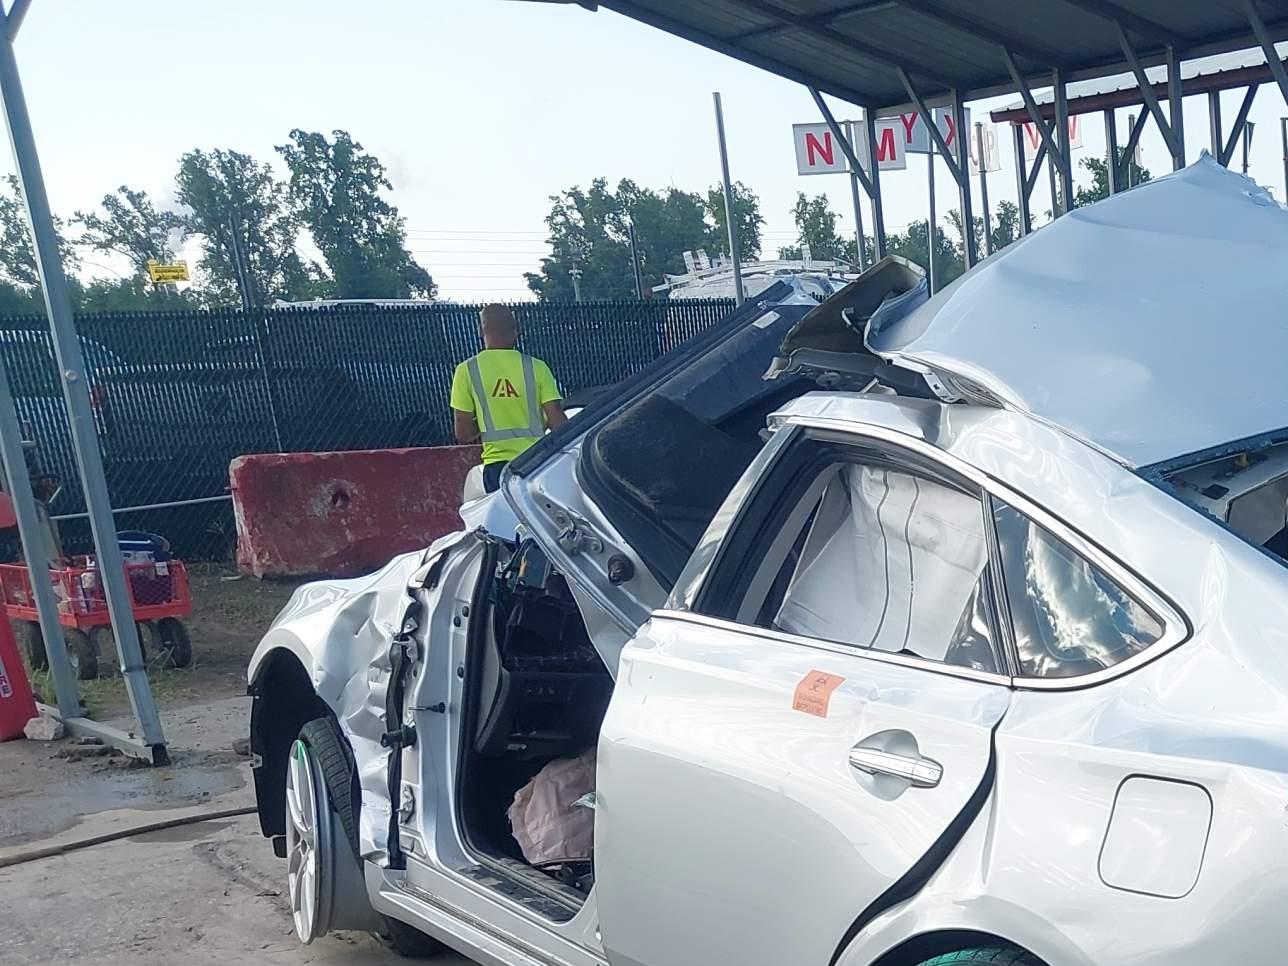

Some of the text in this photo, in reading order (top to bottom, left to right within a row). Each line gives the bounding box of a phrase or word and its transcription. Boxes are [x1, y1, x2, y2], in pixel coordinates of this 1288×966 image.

[900, 111, 919, 144] Y
[805, 131, 834, 166] N
[876, 128, 897, 162] M
